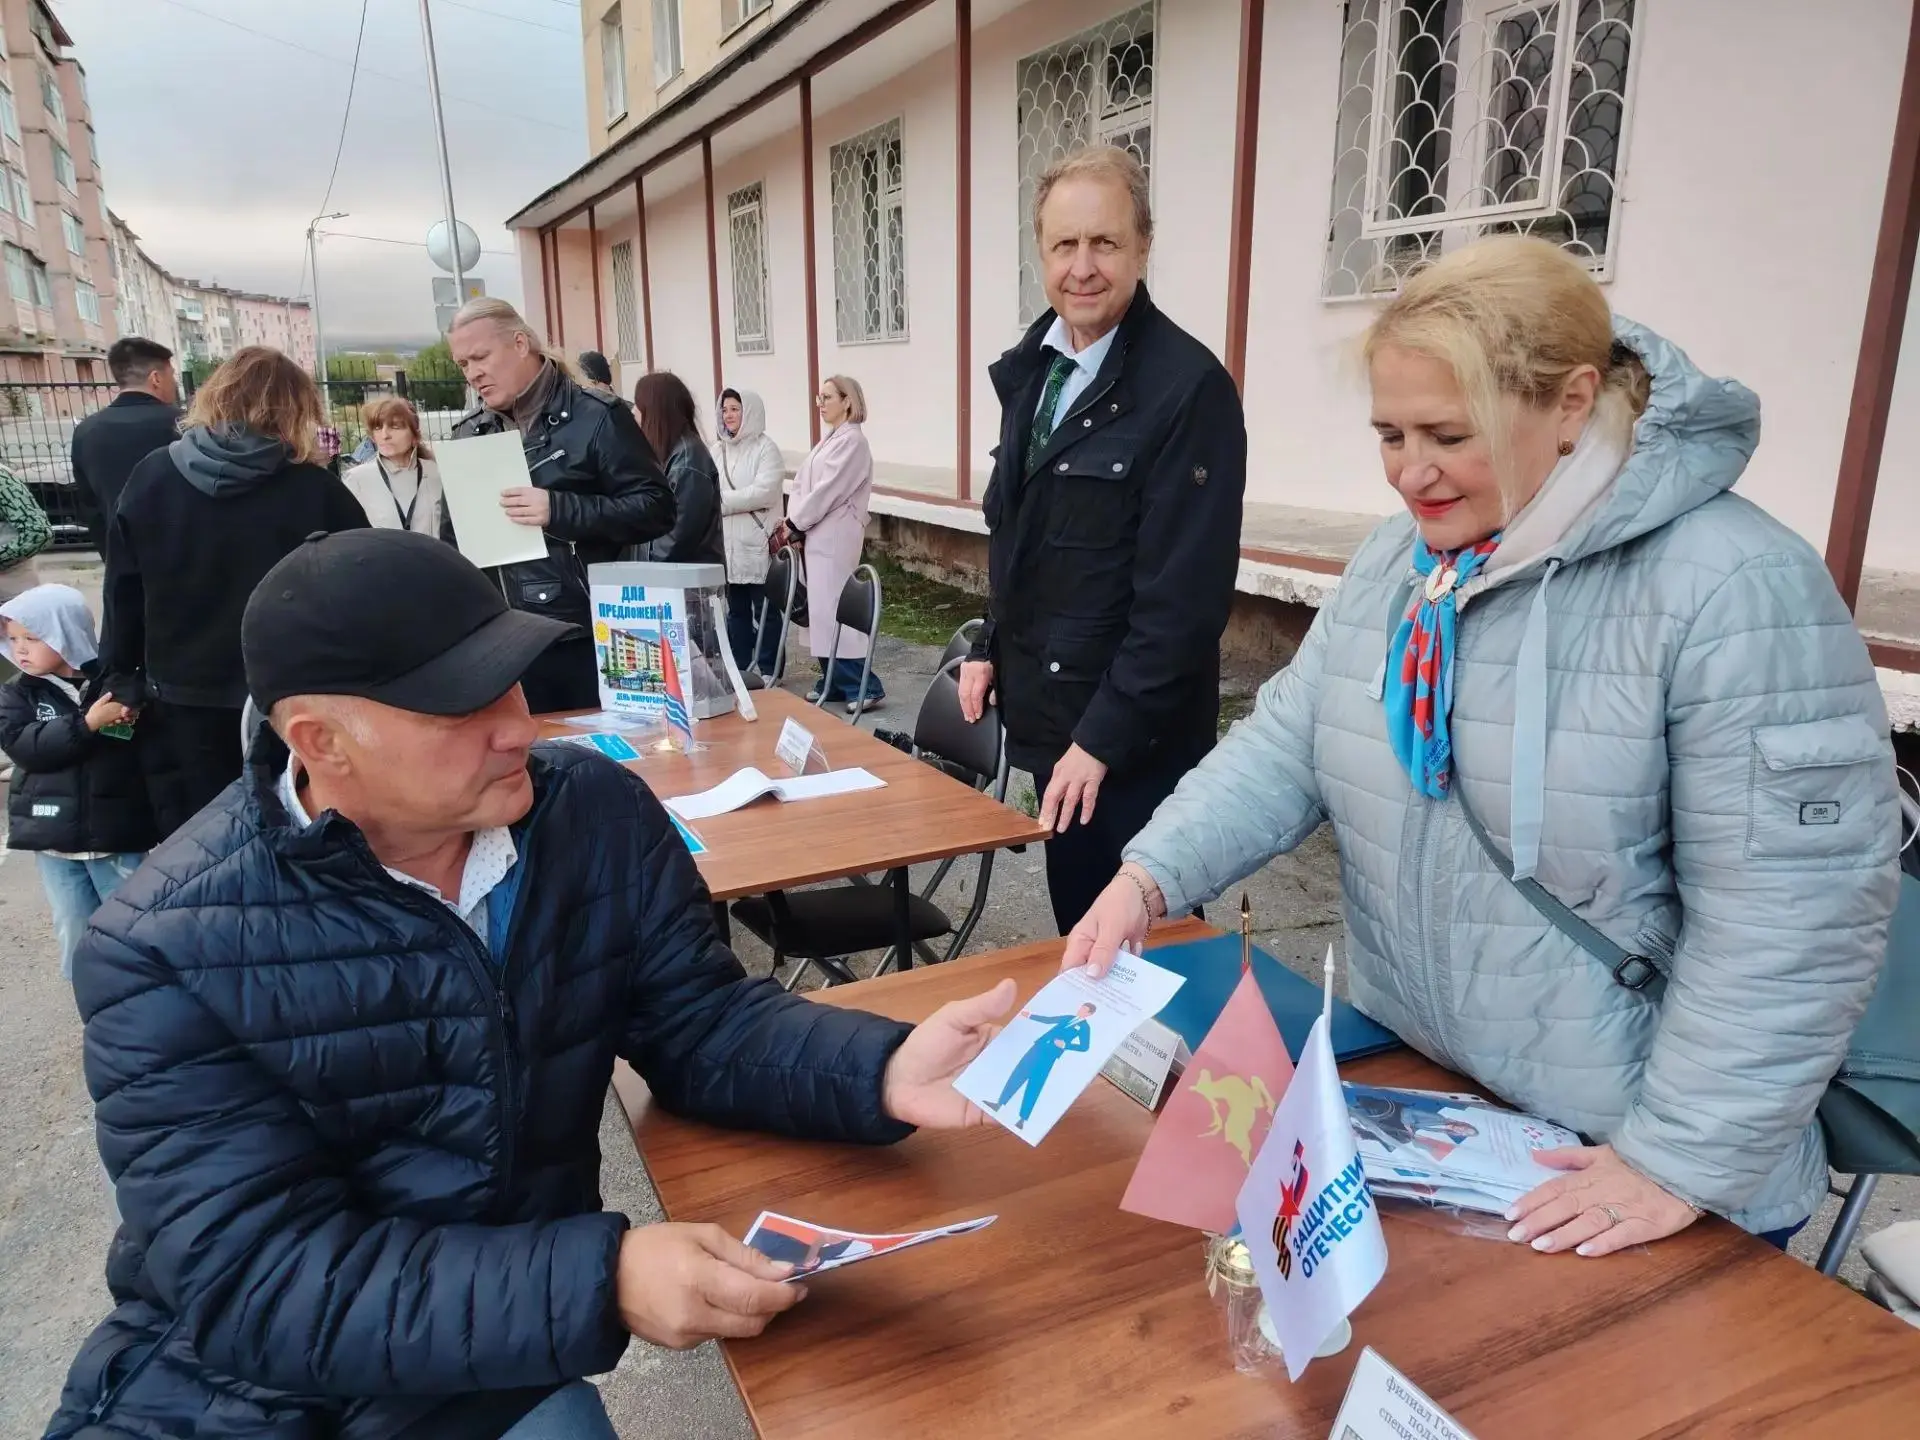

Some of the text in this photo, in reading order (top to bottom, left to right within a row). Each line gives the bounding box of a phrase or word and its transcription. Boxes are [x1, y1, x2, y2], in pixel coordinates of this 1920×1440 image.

[621, 586, 645, 603] ДЛЯ
[1293, 1151, 1364, 1257] ЗАЩИТНИ
[1302, 1178, 1373, 1278] ОТЕЧЕСТ
[1379, 1407, 1418, 1440] специ
[1386, 1375, 1460, 1440] филиал Гос
